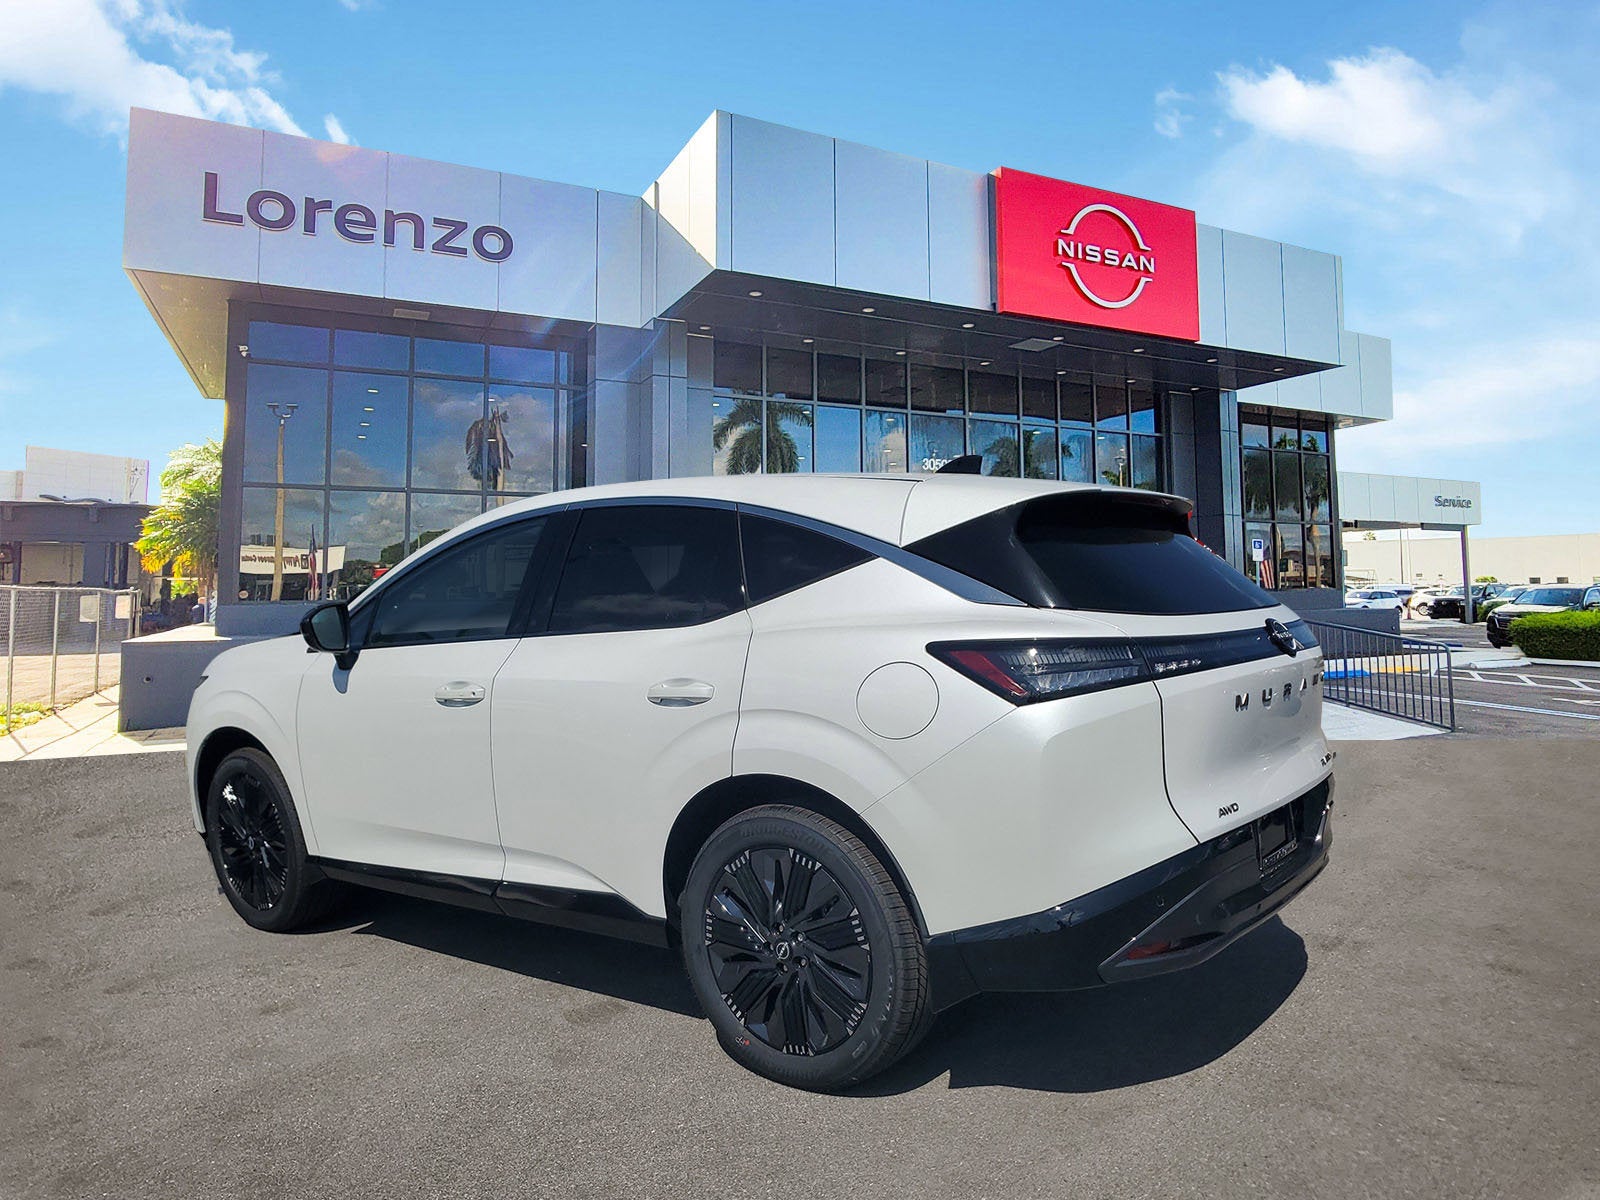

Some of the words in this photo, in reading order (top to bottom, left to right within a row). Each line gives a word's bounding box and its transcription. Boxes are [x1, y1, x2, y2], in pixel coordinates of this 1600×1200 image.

[203, 171, 513, 262] Lorenzo
[1057, 238, 1155, 273] NISSAN
[922, 457, 952, 471] 3050
[1434, 495, 1472, 508] Service
[1218, 802, 1239, 818] AWD
